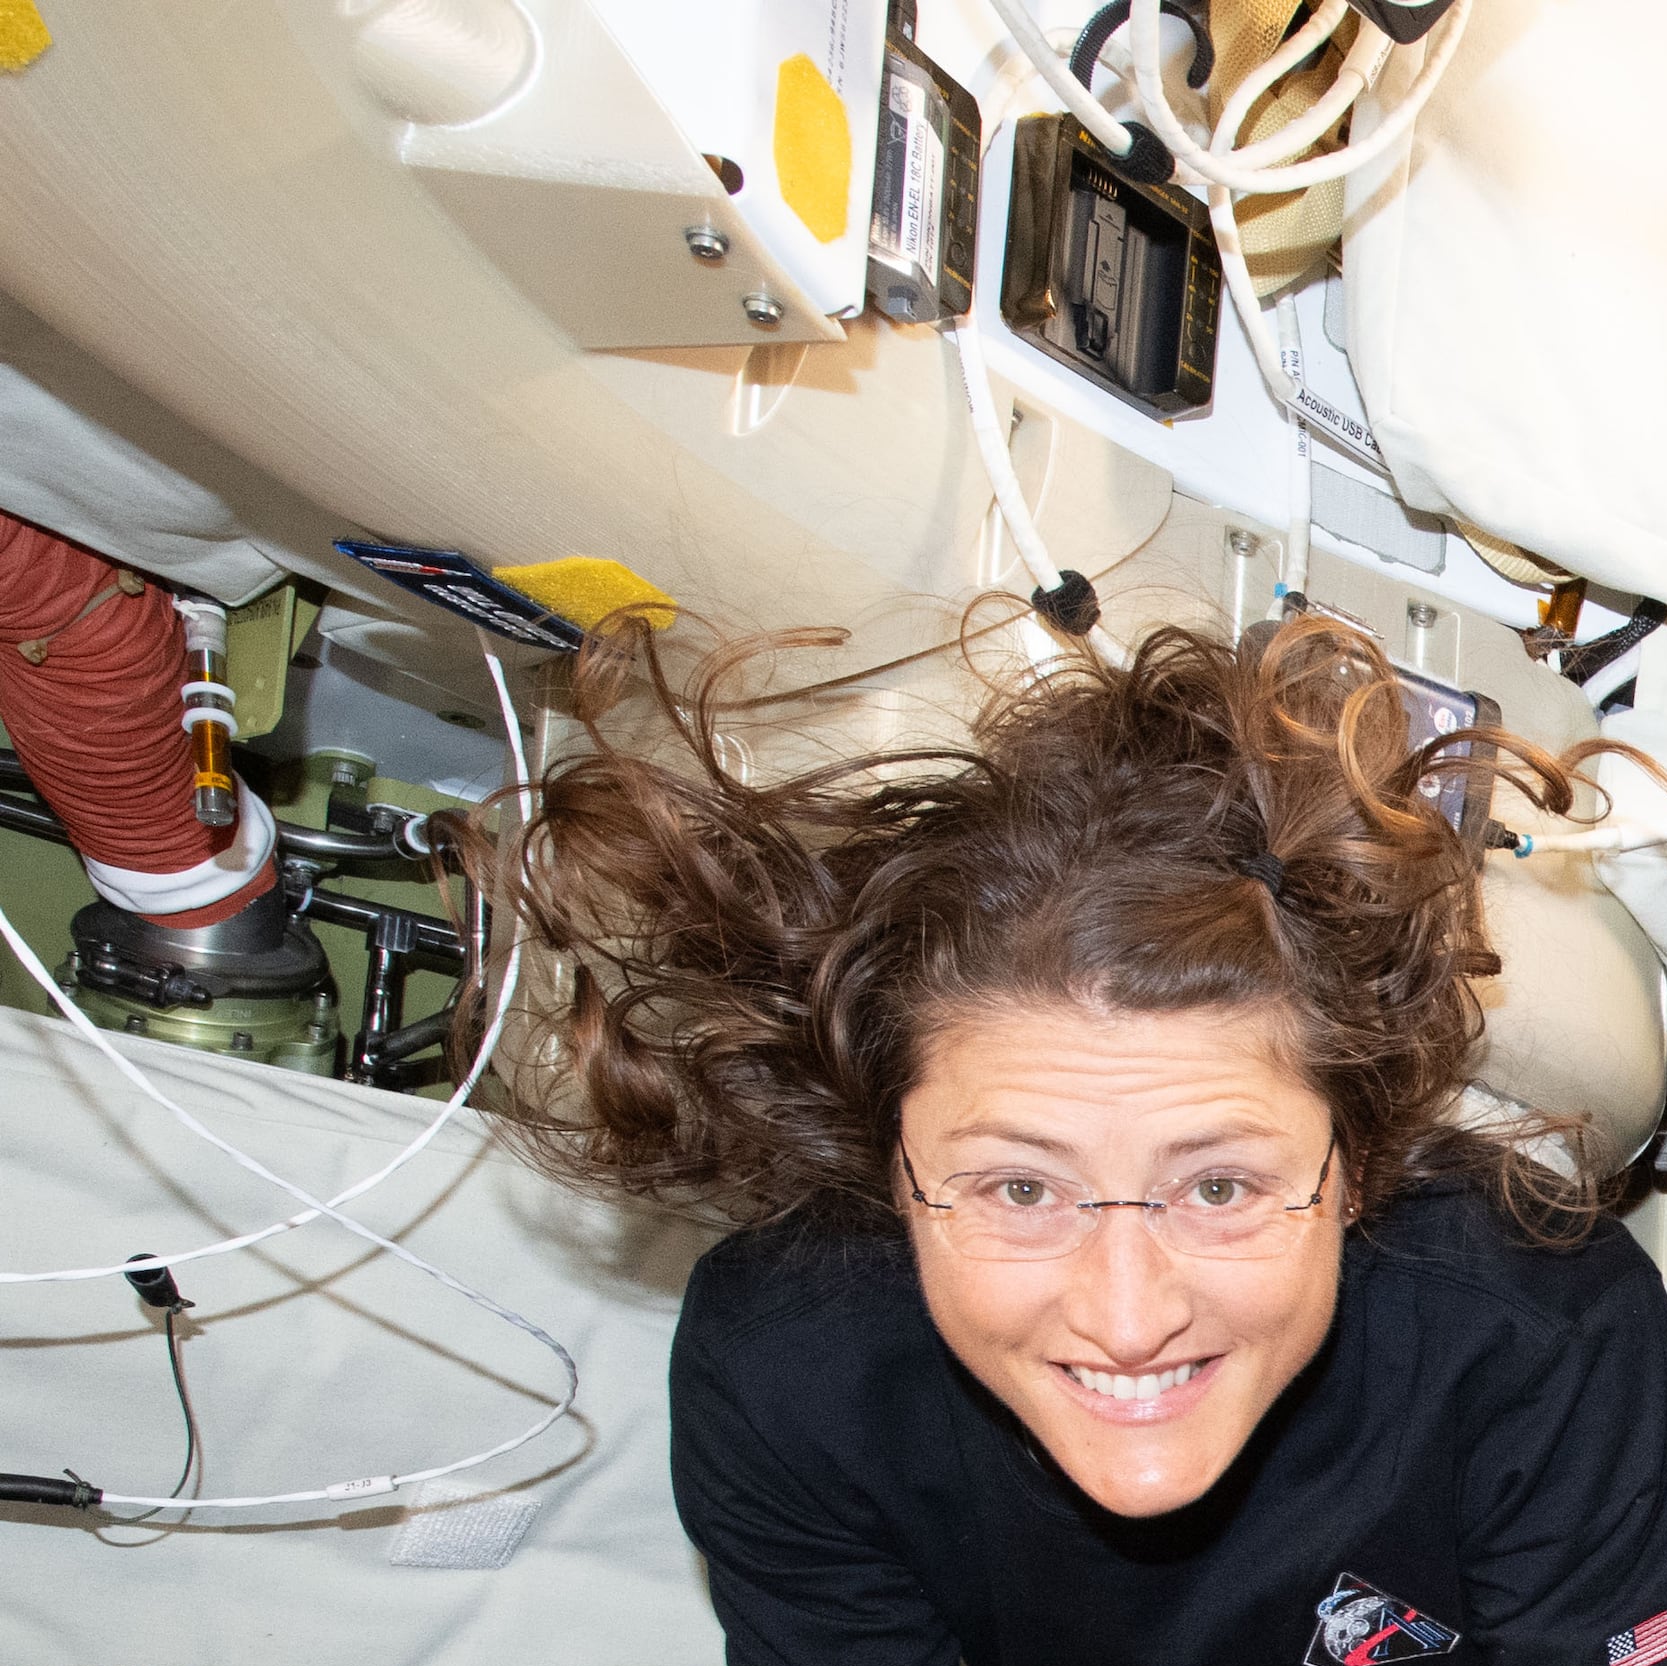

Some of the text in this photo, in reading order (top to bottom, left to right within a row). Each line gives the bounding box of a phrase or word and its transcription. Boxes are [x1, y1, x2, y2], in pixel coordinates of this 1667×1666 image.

[911, 122, 928, 161] Battery
[909, 183, 922, 223] EN-EL
[905, 223, 921, 256] Nikon
[1296, 388, 1340, 425] Acoustic
[1341, 415, 1364, 440] USB
